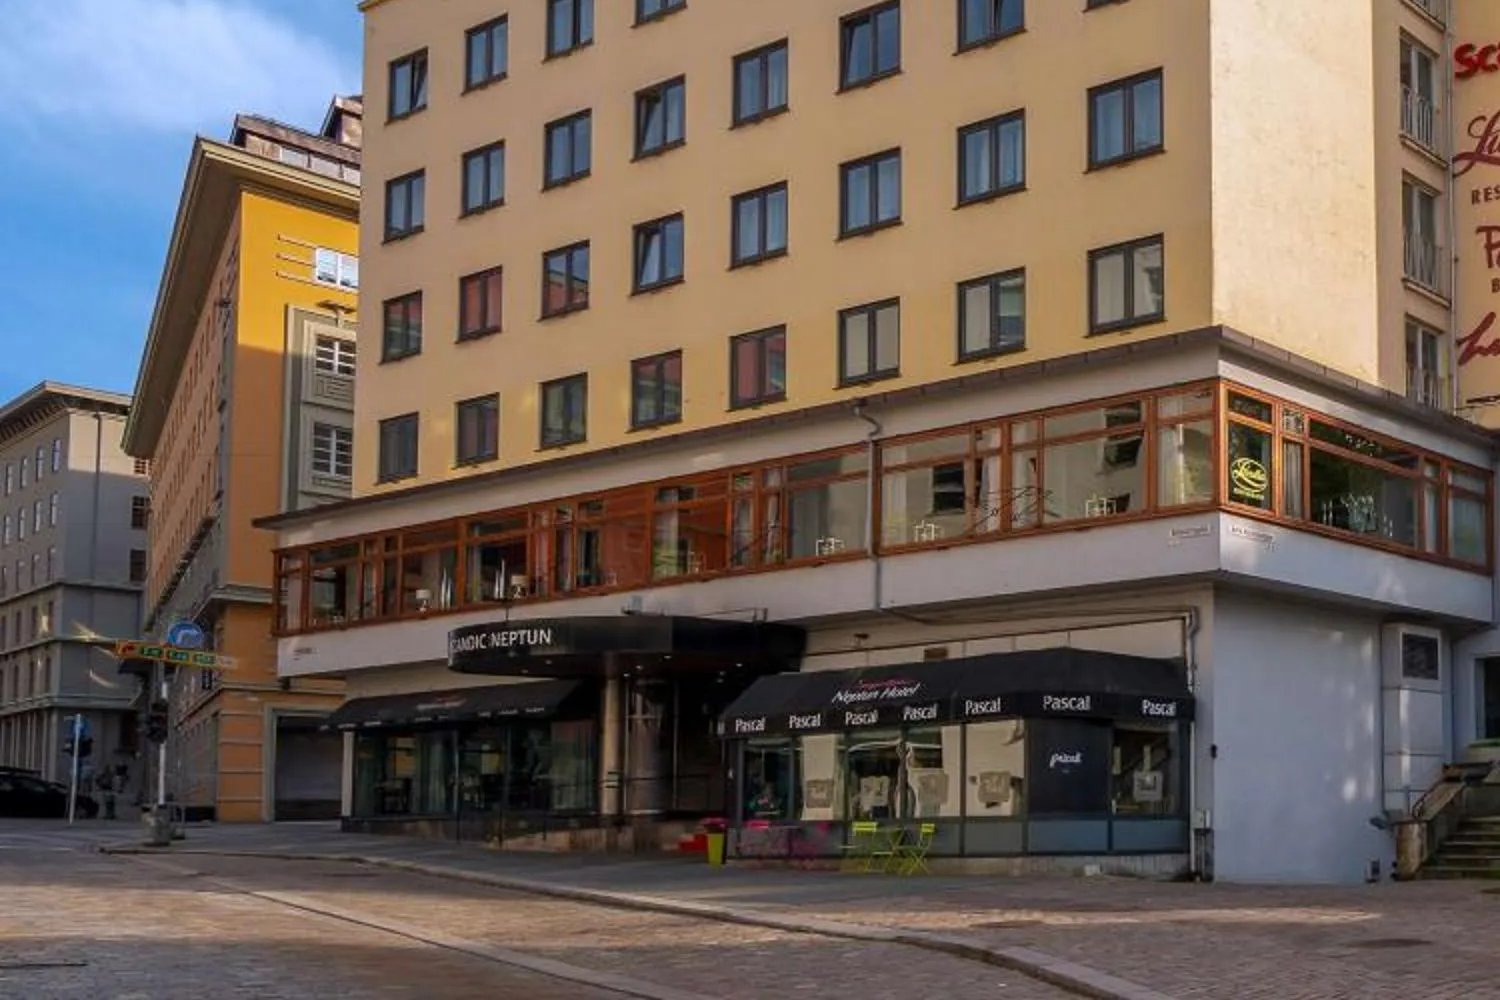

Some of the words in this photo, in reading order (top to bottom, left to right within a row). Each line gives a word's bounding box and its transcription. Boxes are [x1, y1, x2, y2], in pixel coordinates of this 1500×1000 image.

[491, 628, 552, 648] NEPTUN
[965, 697, 1001, 715] Pascal
[1043, 695, 1091, 711] Pascal
[1142, 699, 1177, 716] Pascal
[845, 709, 879, 725] Pascal
[903, 703, 938, 721] Pascal
[789, 713, 821, 729] Pascal
